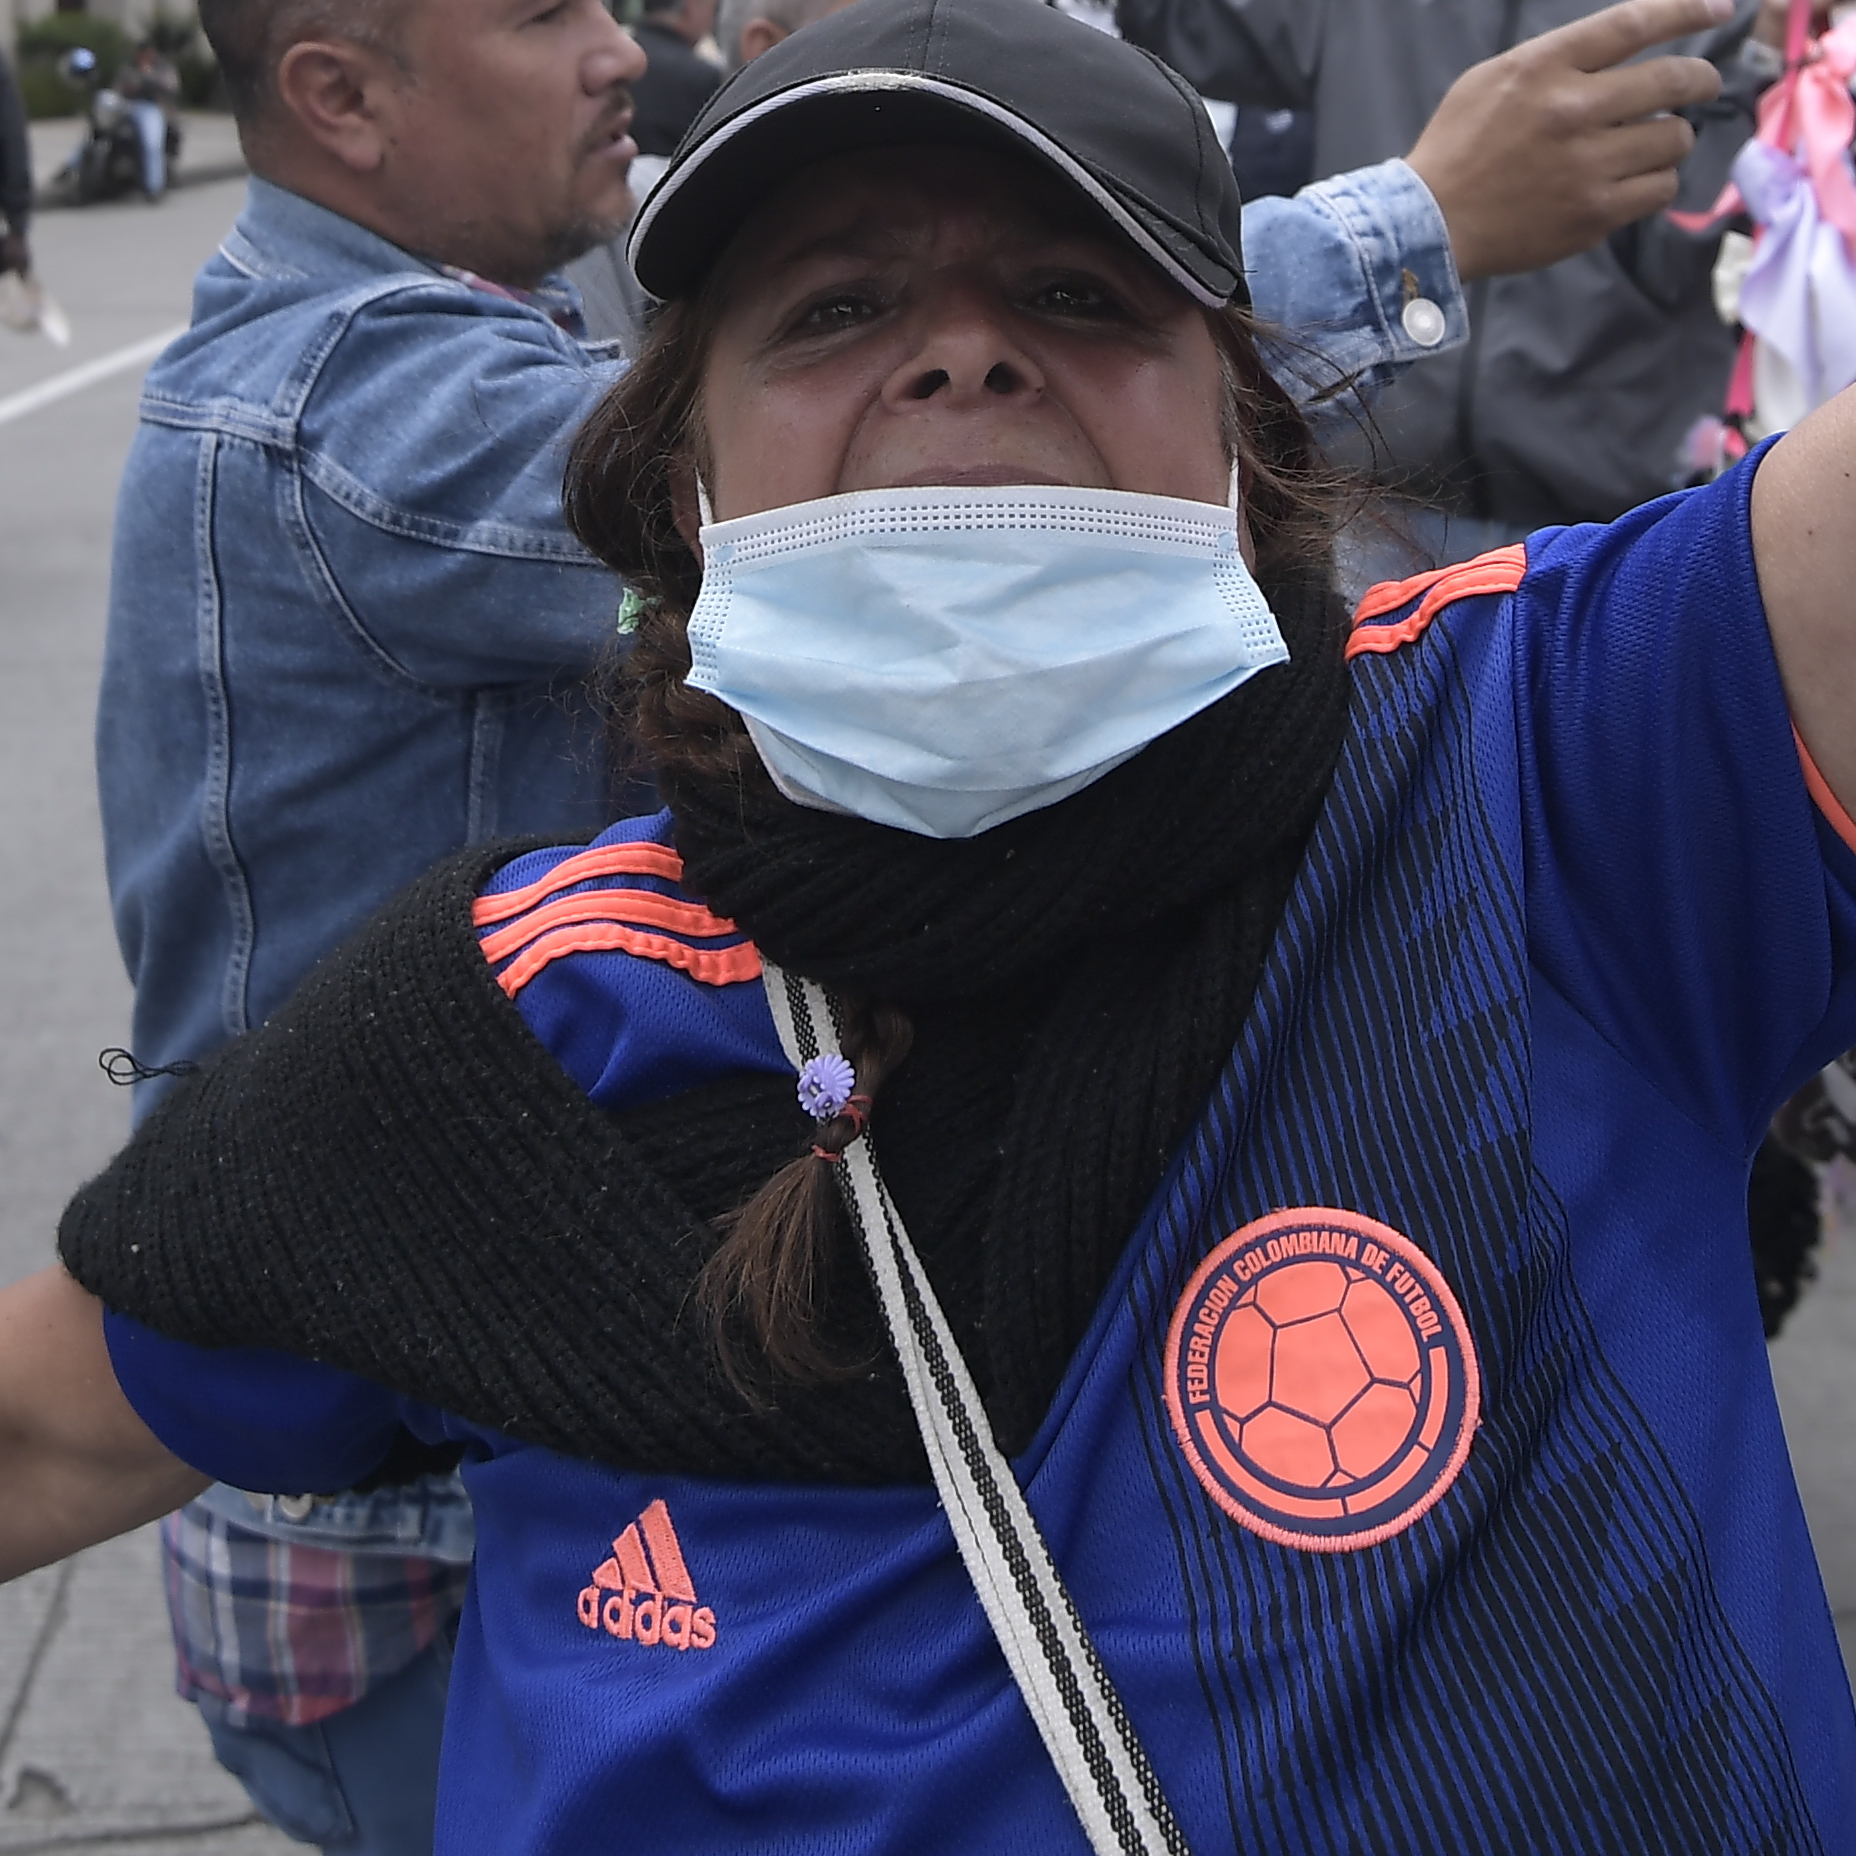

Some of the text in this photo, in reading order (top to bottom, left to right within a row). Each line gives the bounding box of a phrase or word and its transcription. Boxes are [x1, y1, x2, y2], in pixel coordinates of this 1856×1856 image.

[1188, 1230, 1444, 1404] FEDERACION COLOMBIANA DE FUTBOL
[577, 1586, 718, 1651] adidas
